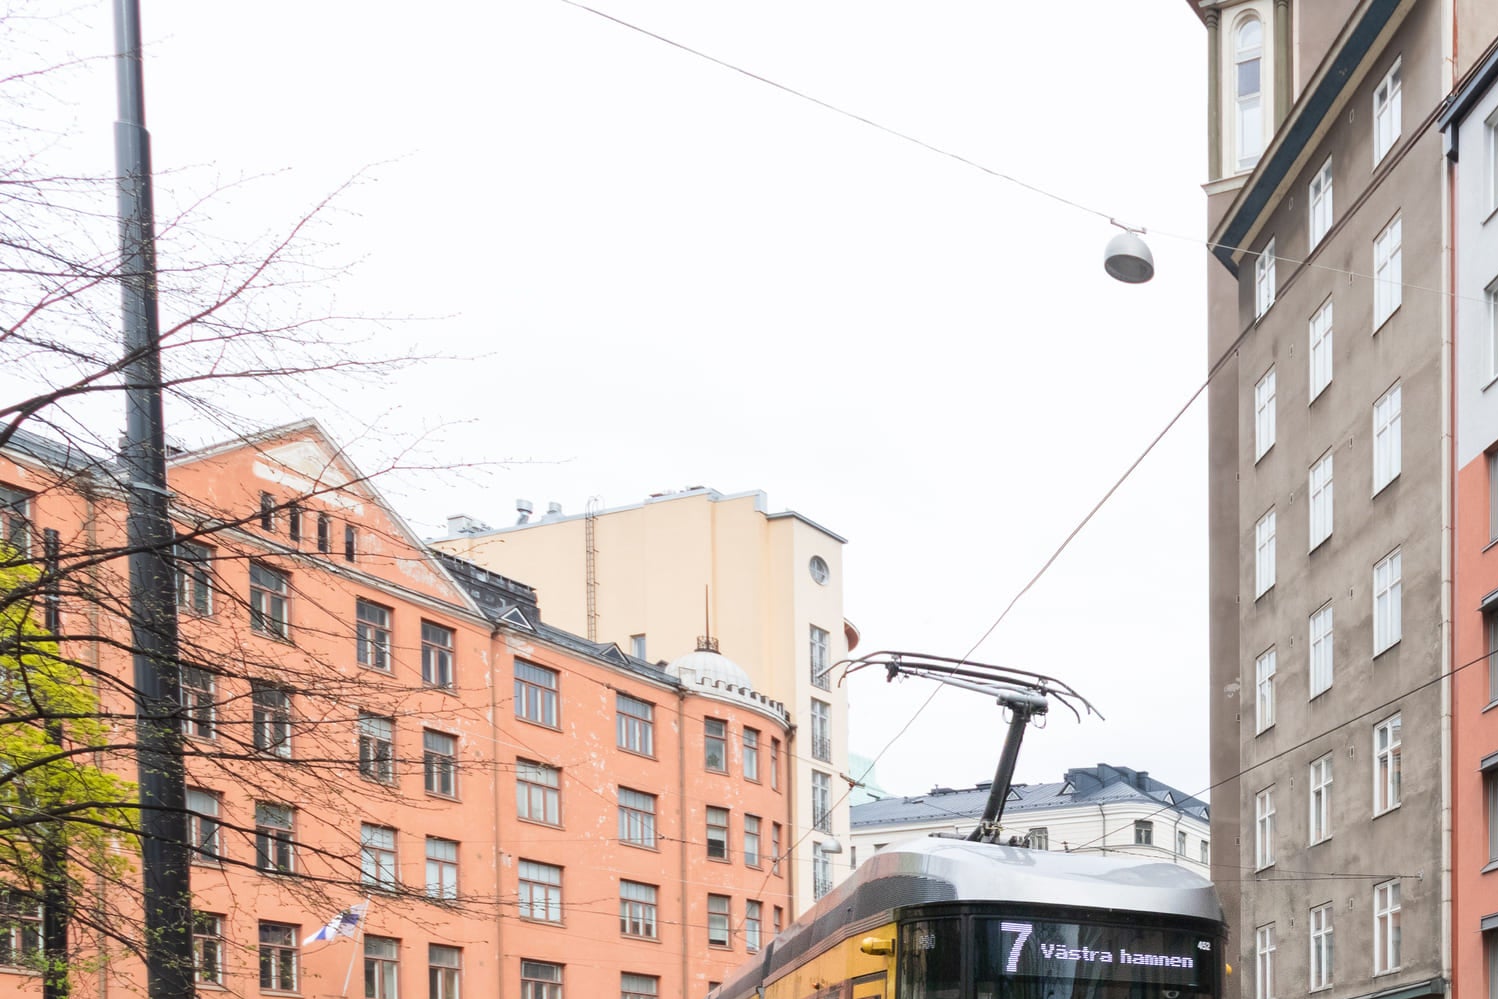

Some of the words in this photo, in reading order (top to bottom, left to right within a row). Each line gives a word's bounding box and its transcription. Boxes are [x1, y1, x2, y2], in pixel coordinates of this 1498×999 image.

[1001, 922, 1033, 972] 7
[1041, 943, 1113, 963] Västra
[1120, 949, 1194, 968] hamnen
